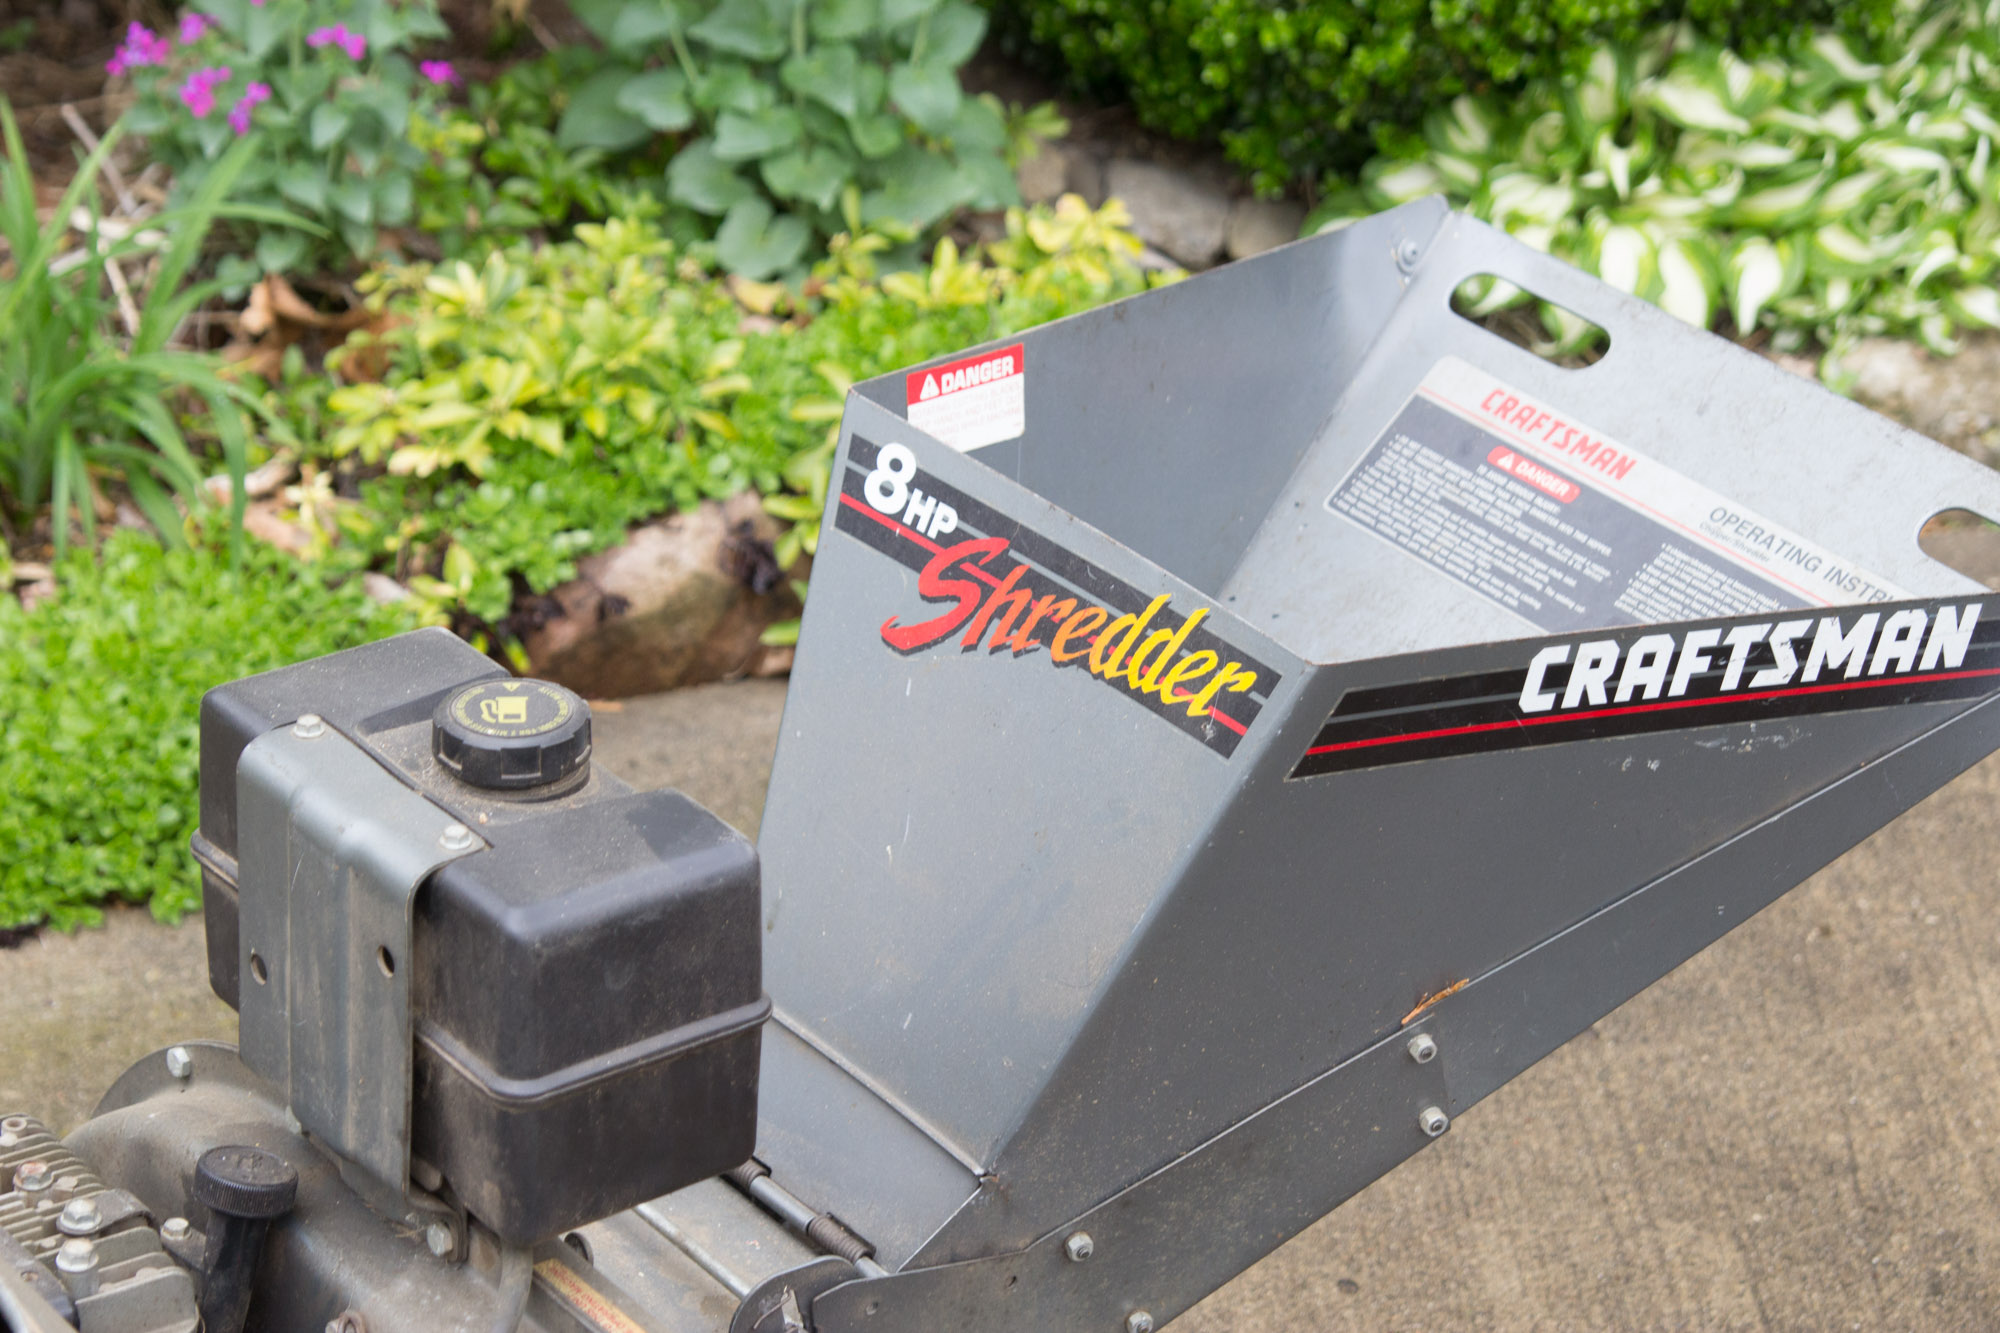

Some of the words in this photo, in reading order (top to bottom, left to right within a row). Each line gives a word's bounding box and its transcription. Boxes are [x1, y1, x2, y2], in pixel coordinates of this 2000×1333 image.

[941, 355, 1014, 395] DANGER
[1480, 388, 1637, 480] CRAFTSMAN
[1515, 460, 1570, 497] DANGER
[1709, 507, 1823, 574] OPERATING
[1823, 565, 1894, 603] INSTR
[879, 536, 1258, 718] Shredder
[1519, 603, 1983, 713] CRAFTSMAN
